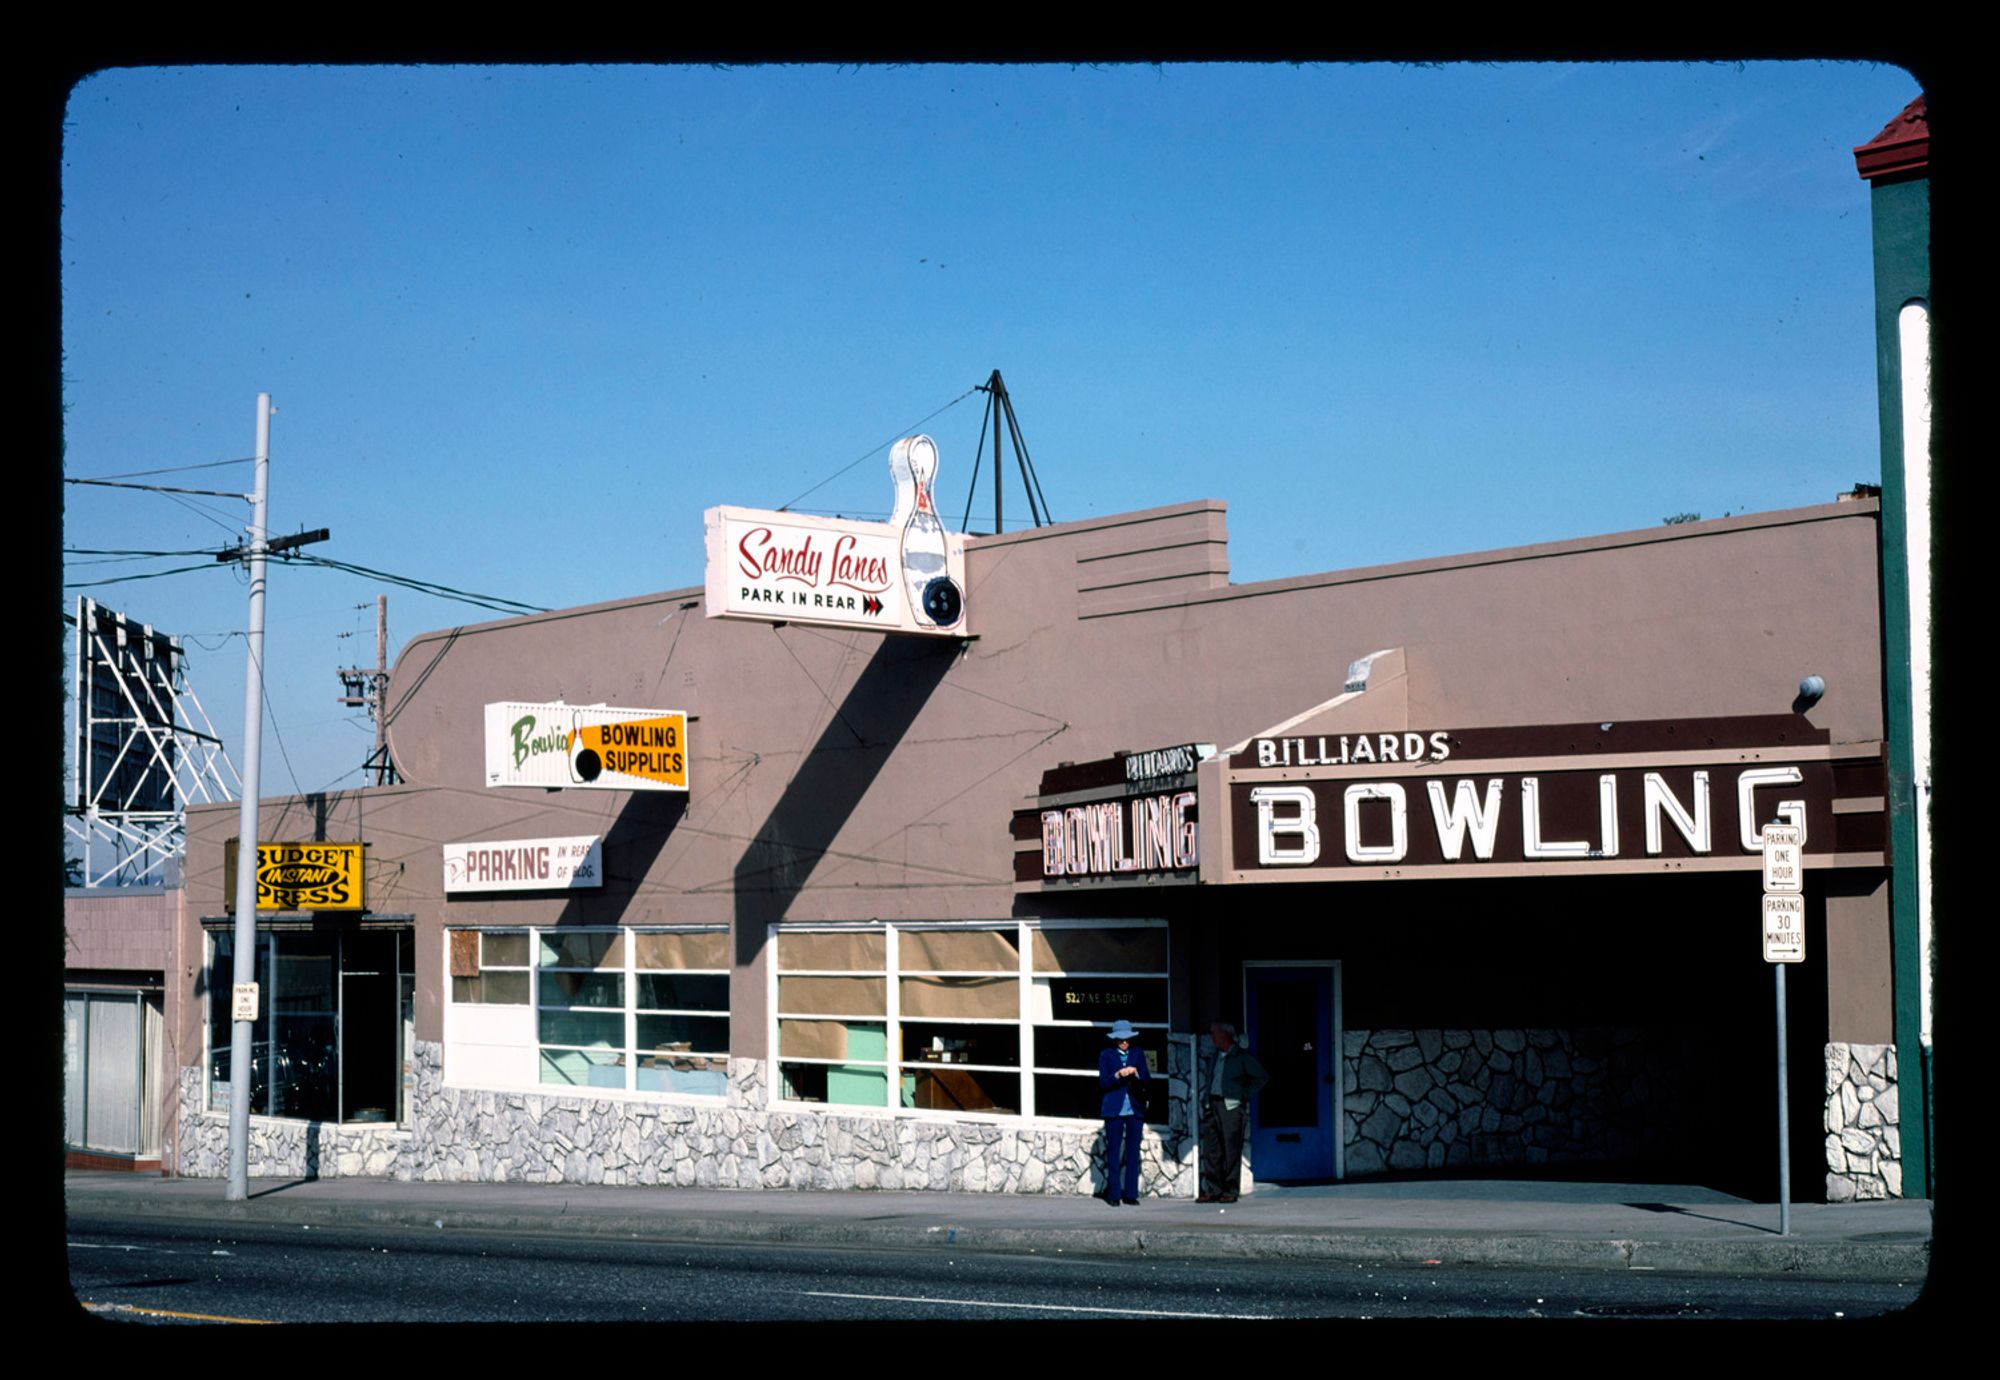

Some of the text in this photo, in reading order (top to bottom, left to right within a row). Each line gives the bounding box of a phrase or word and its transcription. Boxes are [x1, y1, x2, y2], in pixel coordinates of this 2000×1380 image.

[739, 528, 893, 593] Sandy Lanes
[742, 587, 855, 609] PARK IN REAR
[601, 725, 676, 747] BOWLING
[1258, 732, 1450, 767] BILLIARDS
[1250, 767, 1807, 867] BOWLING
[1041, 792, 1196, 875] BOWLING
[1766, 833, 1798, 845] PARKING
[557, 845, 592, 858] IN REAR
[1775, 850, 1790, 862] ONE
[466, 847, 550, 883] PARKING
[557, 865, 567, 878] OF
[265, 868, 334, 883] INSTANT
[1772, 867, 1793, 879] HOUR
[256, 876, 349, 907] PRESS
[1766, 900, 1800, 912] PARKING
[1777, 915, 1791, 929] 30
[1766, 932, 1801, 945] MINUTES
[1105, 993, 1134, 1004] SANDY
